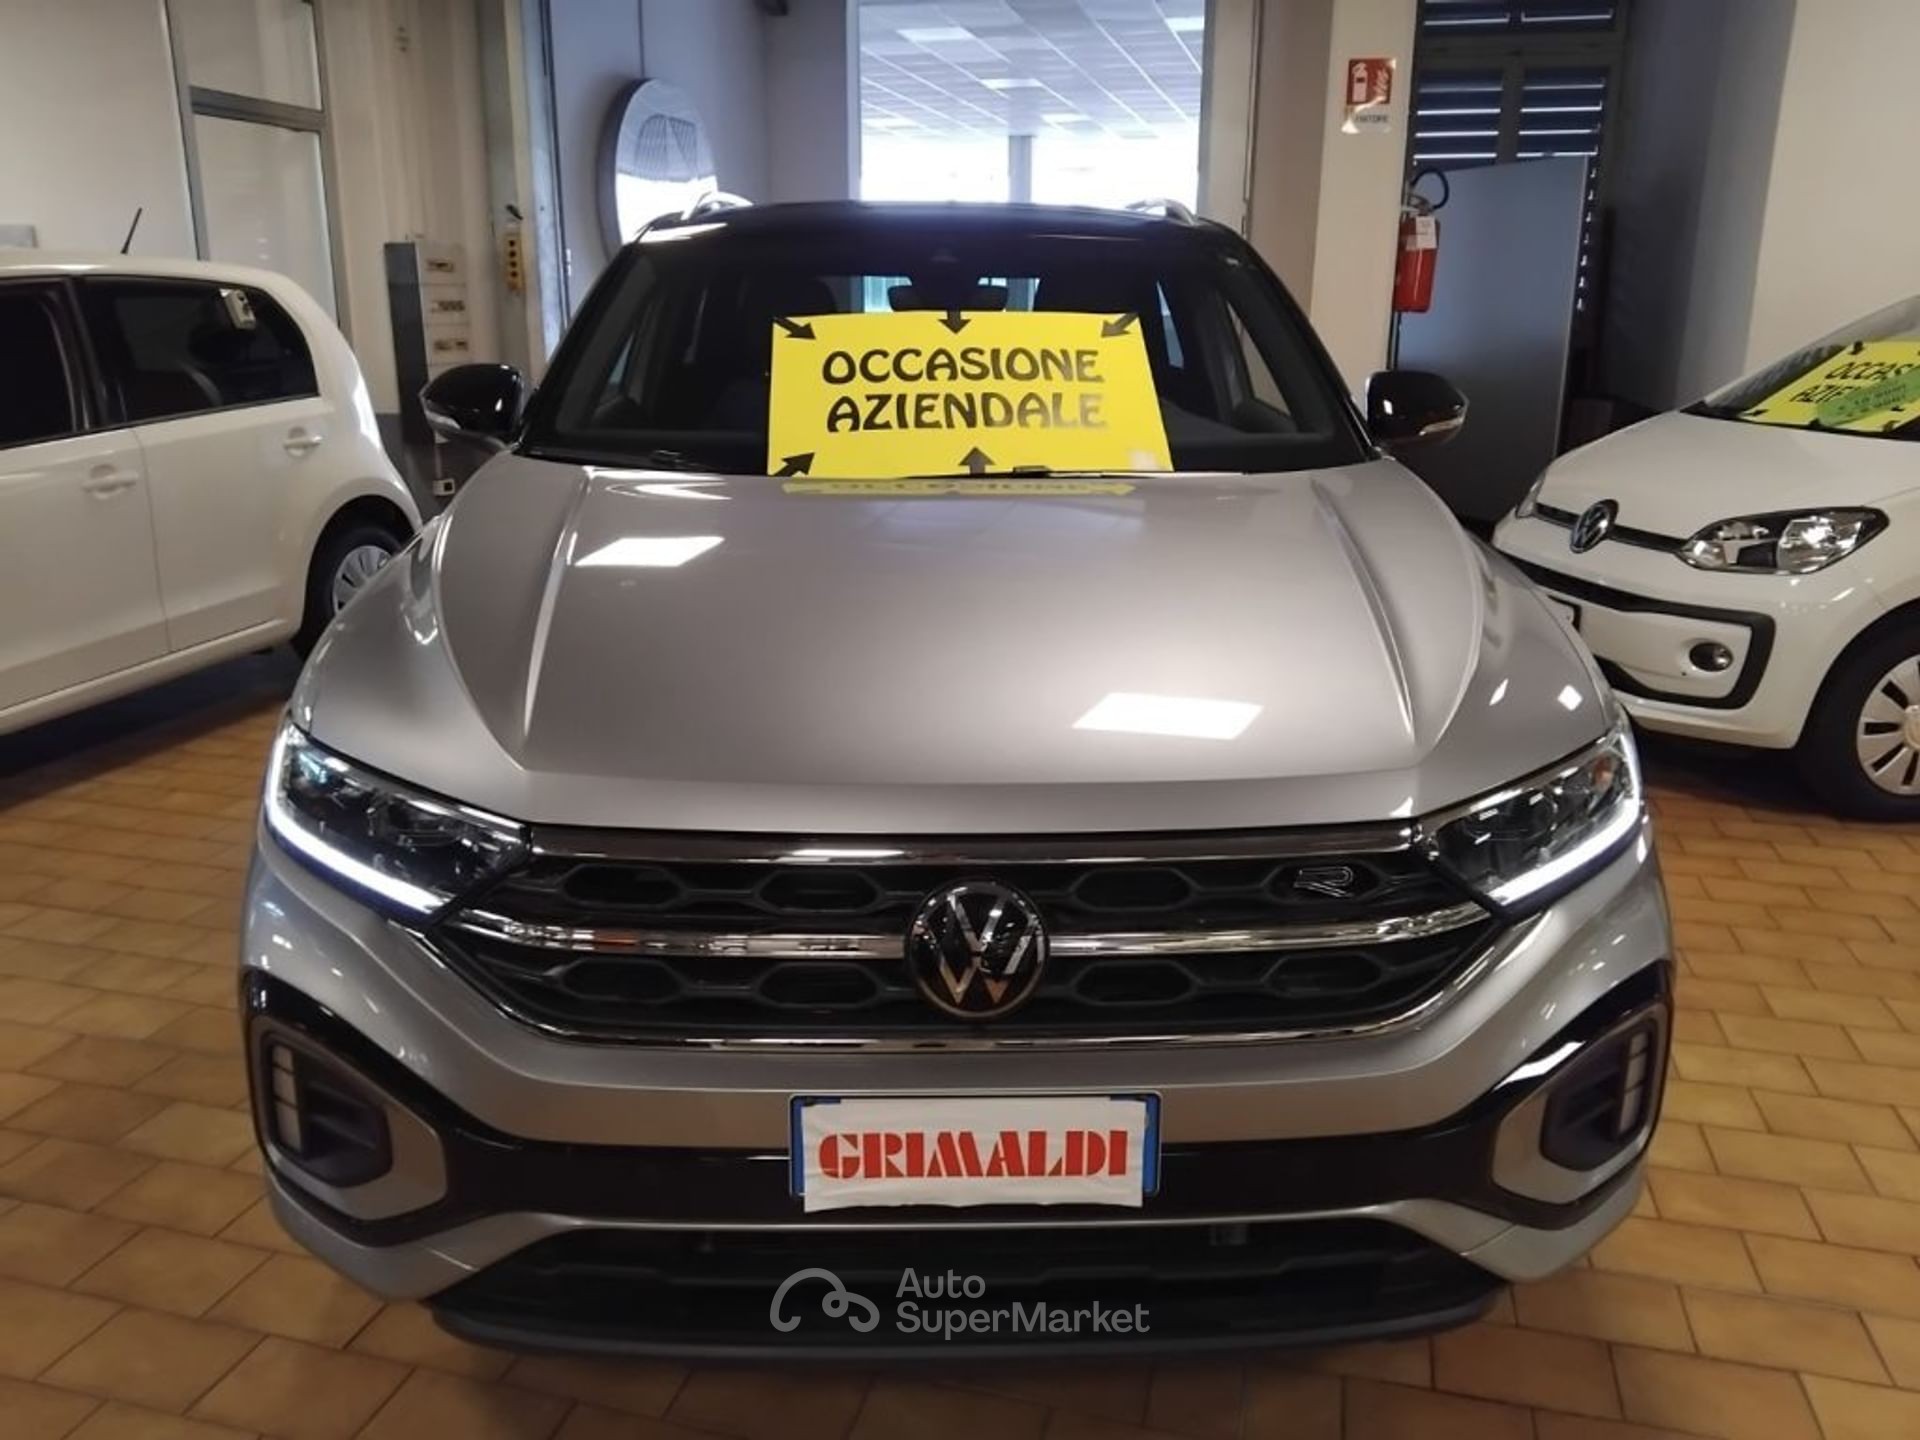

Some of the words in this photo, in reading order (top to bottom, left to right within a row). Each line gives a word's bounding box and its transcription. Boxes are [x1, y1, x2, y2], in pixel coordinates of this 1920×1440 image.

[821, 347, 1105, 384] OCCASIONE
[826, 392, 1107, 433] AZIENDALE
[818, 1130, 1128, 1179] GRIMALDI
